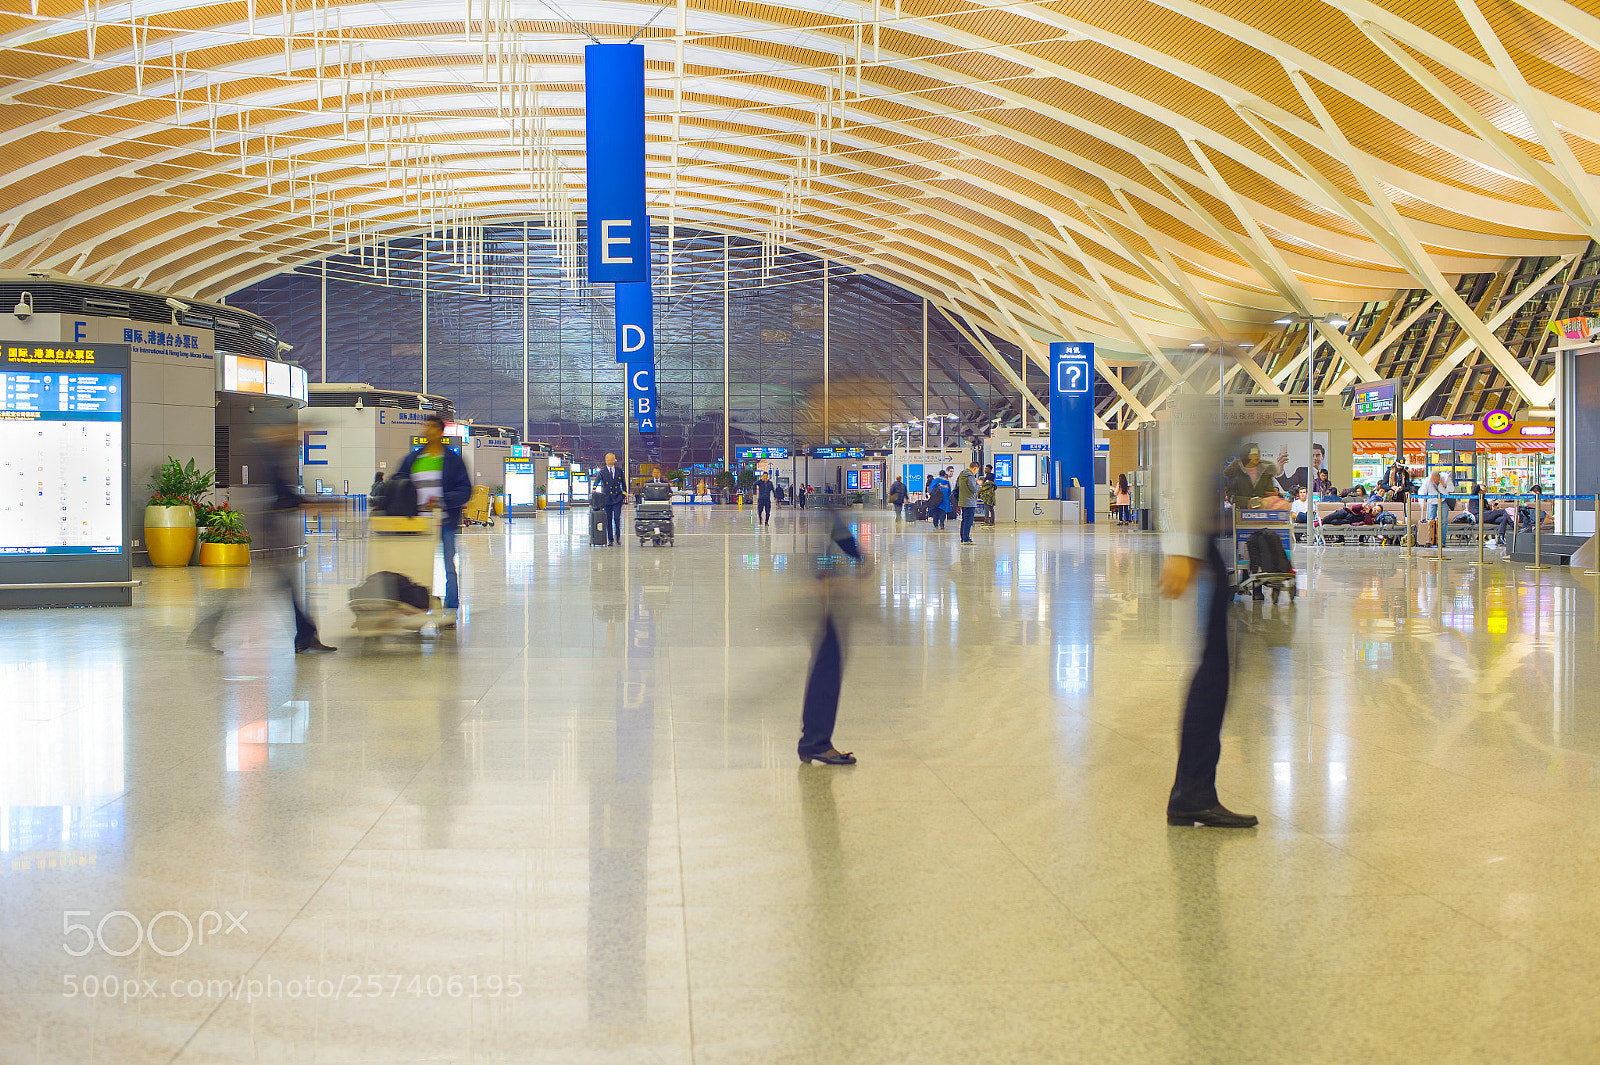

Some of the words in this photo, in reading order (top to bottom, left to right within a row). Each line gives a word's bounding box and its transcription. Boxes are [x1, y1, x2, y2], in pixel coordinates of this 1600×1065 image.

[601, 219, 633, 264] E
[75, 321, 87, 342] F
[123, 328, 199, 350] 国际、港澳台办票区
[622, 324, 646, 353] D
[633, 371, 649, 391] C
[638, 398, 650, 413] B
[380, 410, 386, 424] E
[641, 418, 653, 428] A
[304, 431, 328, 465] E
[475, 438, 482, 448] D
